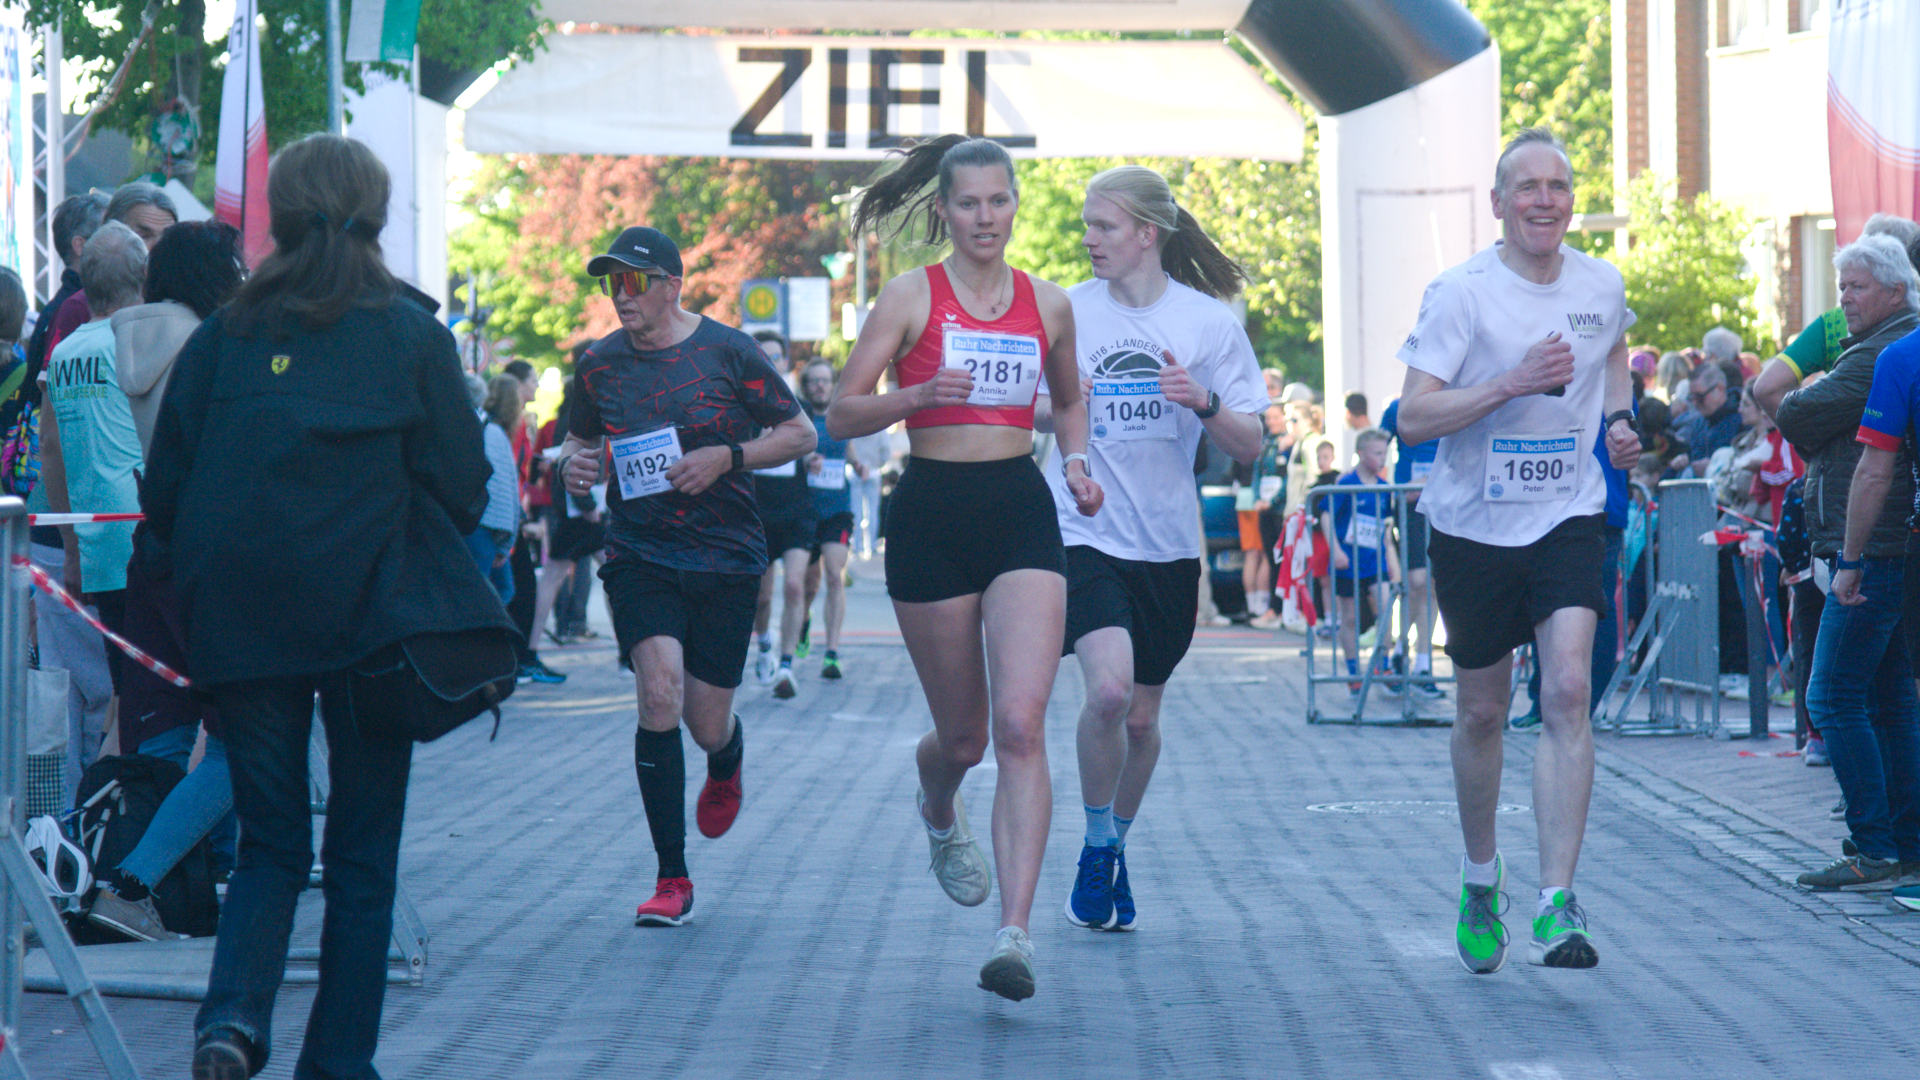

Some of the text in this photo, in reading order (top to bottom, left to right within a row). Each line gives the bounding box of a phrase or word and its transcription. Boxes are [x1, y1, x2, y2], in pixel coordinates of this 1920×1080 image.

[730, 47, 1036, 148] ZIEL
[1575, 313, 1604, 326] WML
[953, 339, 1034, 353] Ruhr Nachrichten
[1089, 345, 1108, 363] U16
[55, 356, 108, 387] WML
[964, 358, 1022, 384] 2181
[978, 386, 1007, 395] Annika
[1095, 382, 1161, 394] Ruhr Nachricht
[1105, 400, 1162, 422] 1040
[1122, 424, 1147, 432] Jakob
[1495, 440, 1574, 452] Ruhr Nachrichten
[626, 453, 670, 479] 4192
[1504, 458, 1563, 481] 1690
[1523, 485, 1545, 493] Peter
